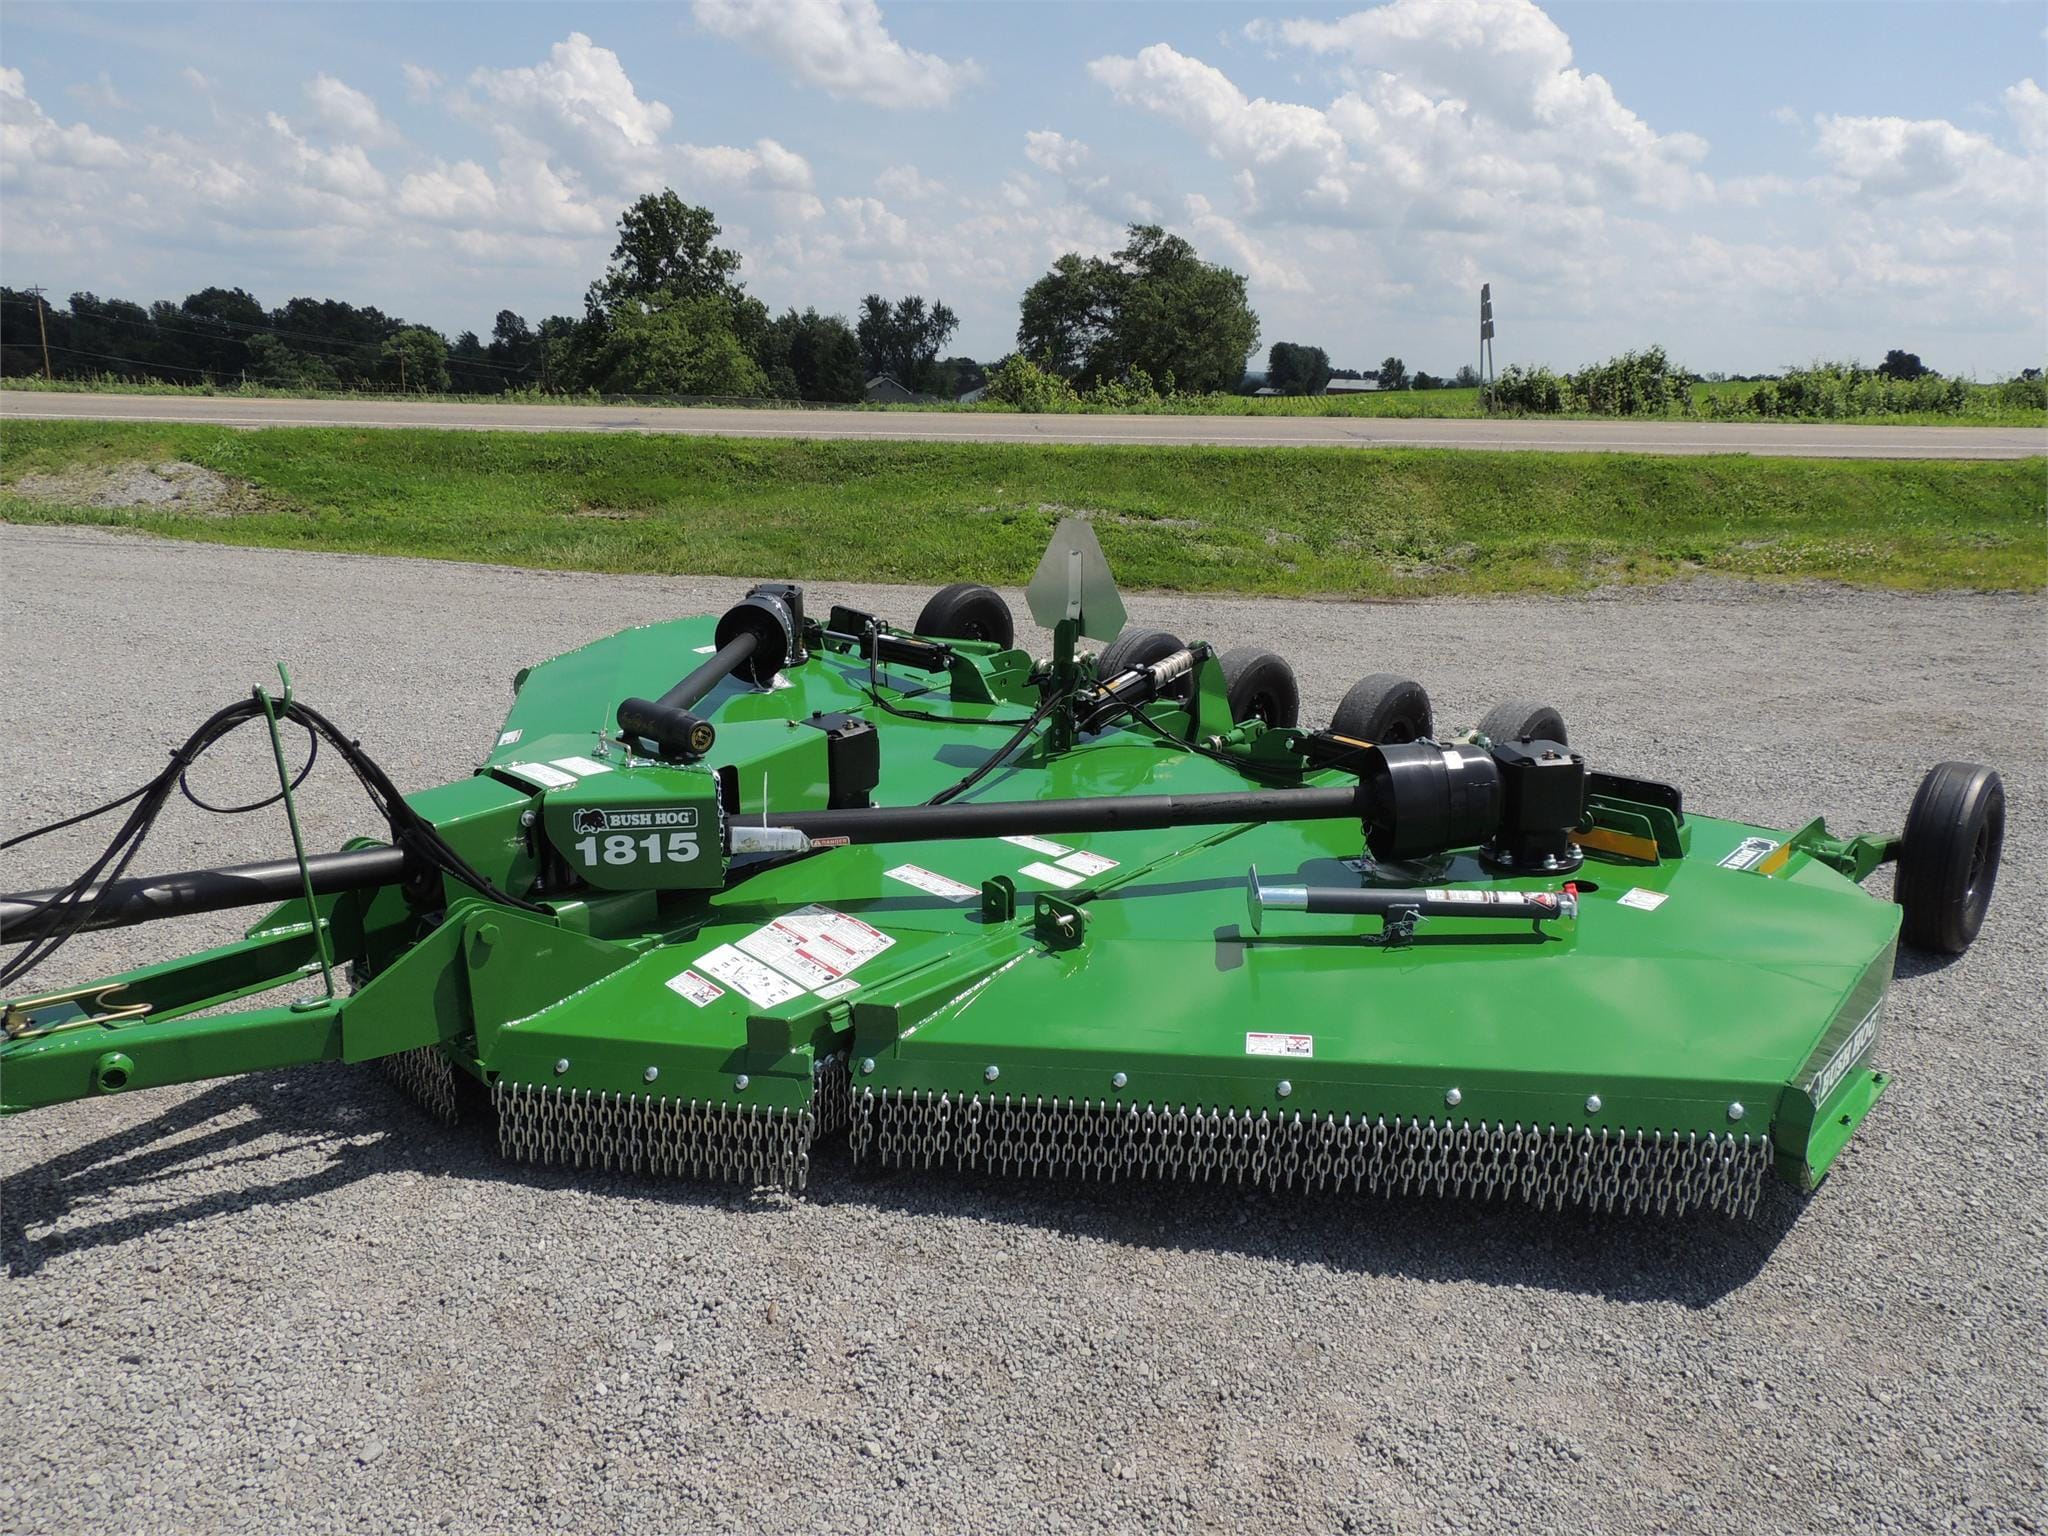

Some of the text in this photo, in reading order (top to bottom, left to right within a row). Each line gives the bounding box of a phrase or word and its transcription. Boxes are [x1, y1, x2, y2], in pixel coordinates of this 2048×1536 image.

[609, 812, 690, 826] BUSH HOG
[575, 832, 700, 866] 1815
[1820, 1010, 1878, 1099] BUSH HOG
